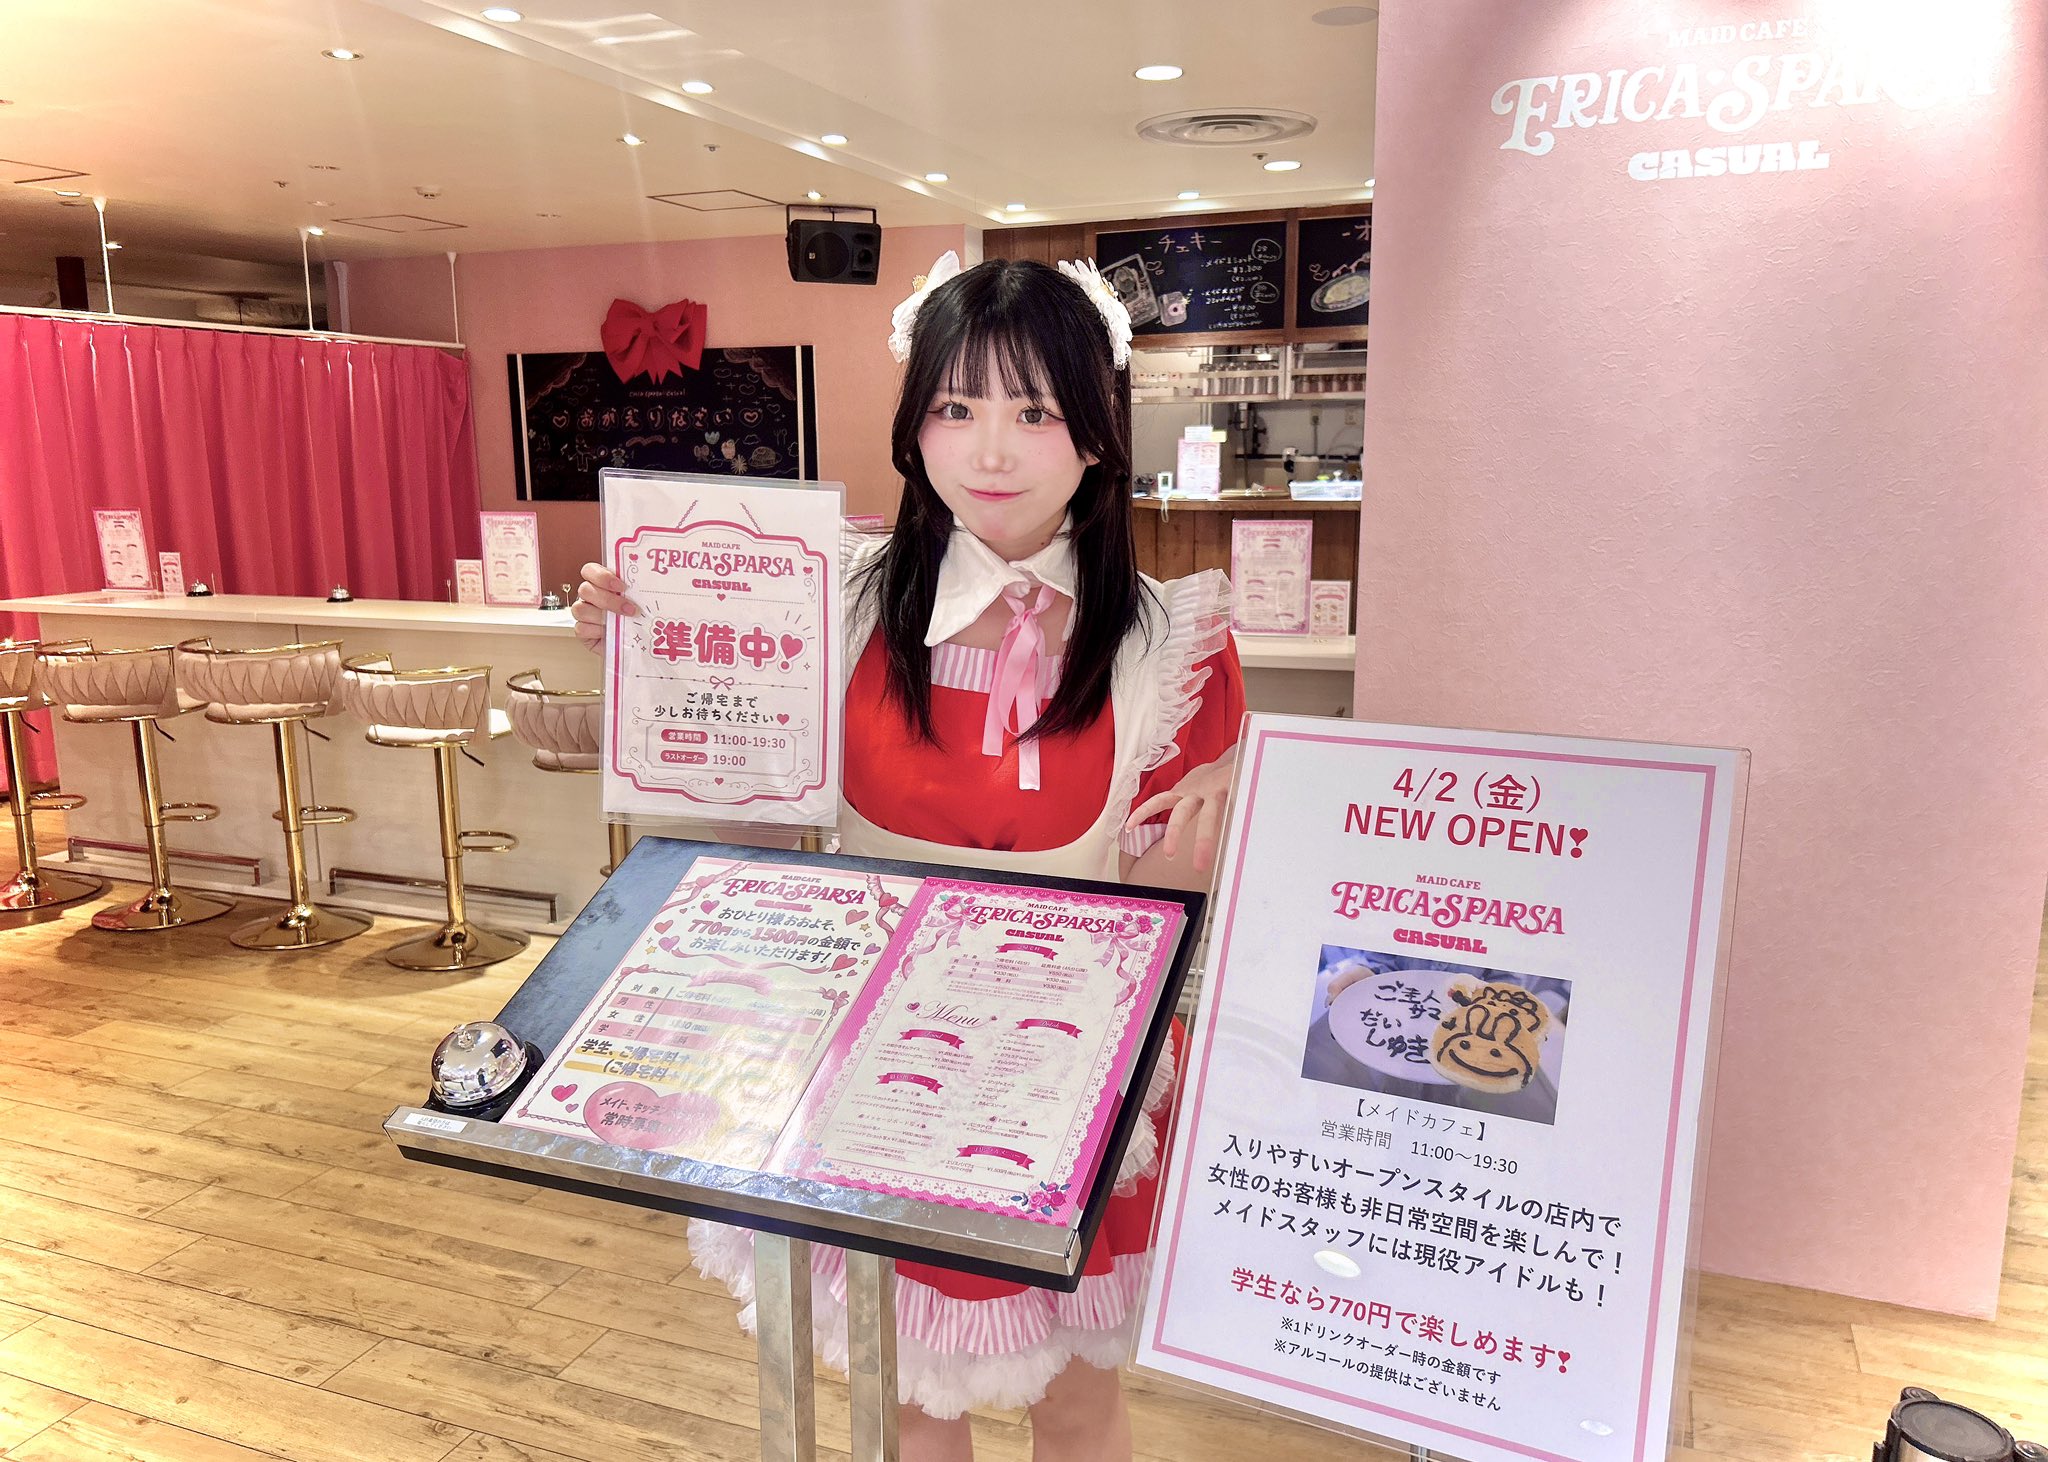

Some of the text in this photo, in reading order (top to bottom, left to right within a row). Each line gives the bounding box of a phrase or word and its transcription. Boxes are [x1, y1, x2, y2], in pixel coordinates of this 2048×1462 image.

[1667, 19, 1808, 49] MAID CAFE
[1491, 62, 1703, 157] ERICA
[1627, 140, 1830, 182] CASUAL
[701, 541, 721, 550] MAID
[646, 548, 795, 577] ERICA SPARSA
[692, 578, 752, 592] CASUAL
[686, 692, 758, 708] ご帰宅まで
[668, 731, 786, 749] 営業時間 11:00-19:30
[664, 753, 746, 766] ラストオーダー 19:00
[1393, 767, 1541, 813] 4/2 (金)
[1344, 803, 1436, 841] NEW
[720, 878, 867, 905] ERICA SPARSA
[1415, 874, 1481, 890] MAID CAFE
[970, 905, 1116, 933] ERICA SPARSA
[1027, 902, 1068, 912] MAID CAFE
[1331, 881, 1565, 936] ERICA SPARSA
[687, 919, 861, 951] 770円から1500円の金額で
[1005, 928, 1065, 942] CASUAL
[1393, 928, 1488, 954] CASUAL
[1375, 979, 1441, 1005] ご主人
[916, 1002, 986, 1028] Menu
[1360, 1006, 1403, 1029] だい
[1408, 1001, 1442, 1022] サマ
[1354, 1097, 1488, 1142] 【メイドカフェ】
[1320, 1118, 1392, 1151] 営業時間
[1222, 1132, 1623, 1238] 入りやすいオープンスタイルの店内で
[1207, 1162, 1623, 1275] 女性のお客様も非日常空間を楽しんで！
[1212, 1197, 1606, 1308] メイドスタッフには現役アイドルも！
[1273, 1337, 1502, 1412] ※アルコールの提供はございません
